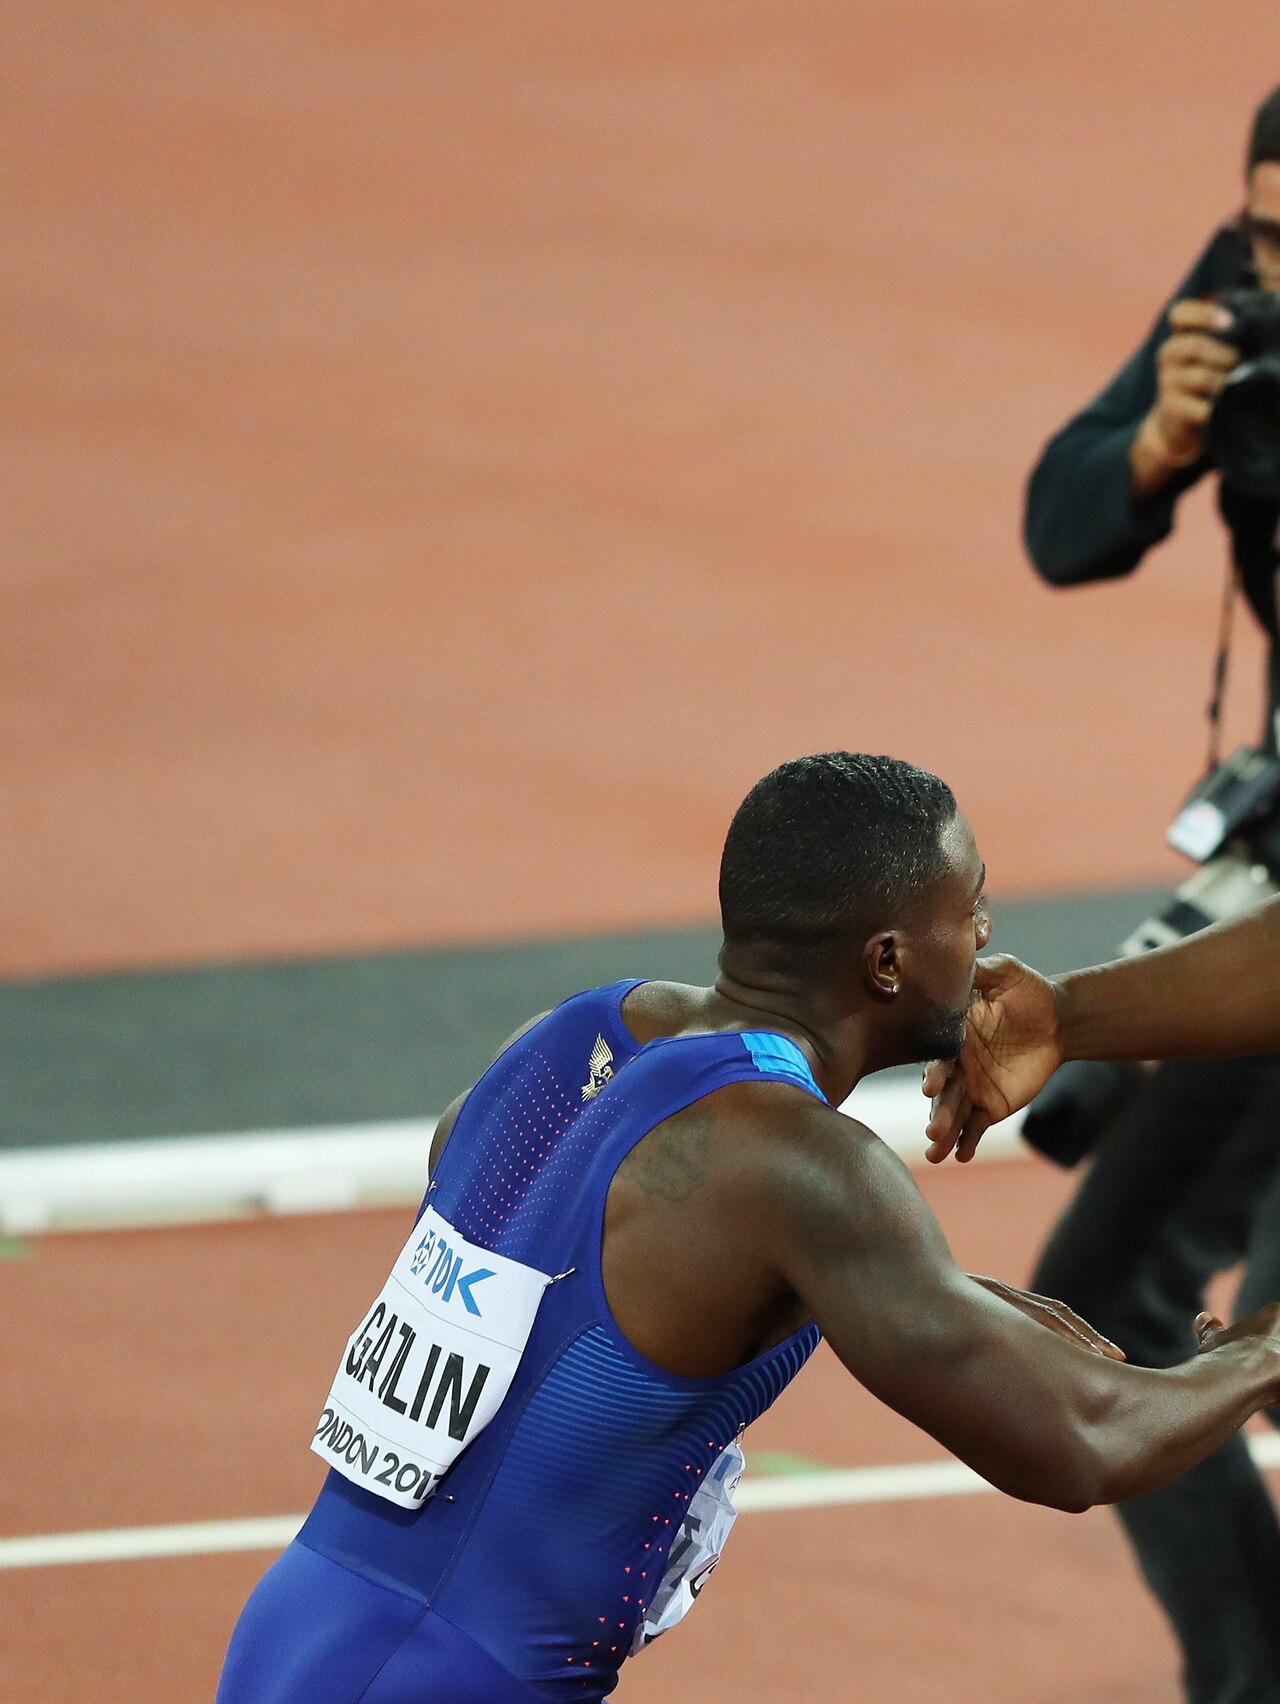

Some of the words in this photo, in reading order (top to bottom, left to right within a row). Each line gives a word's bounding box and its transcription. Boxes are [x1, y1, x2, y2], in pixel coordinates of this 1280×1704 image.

[424, 1237, 498, 1318] TDK
[345, 1301, 491, 1442] GATLIN
[316, 1408, 380, 1475] ONDON
